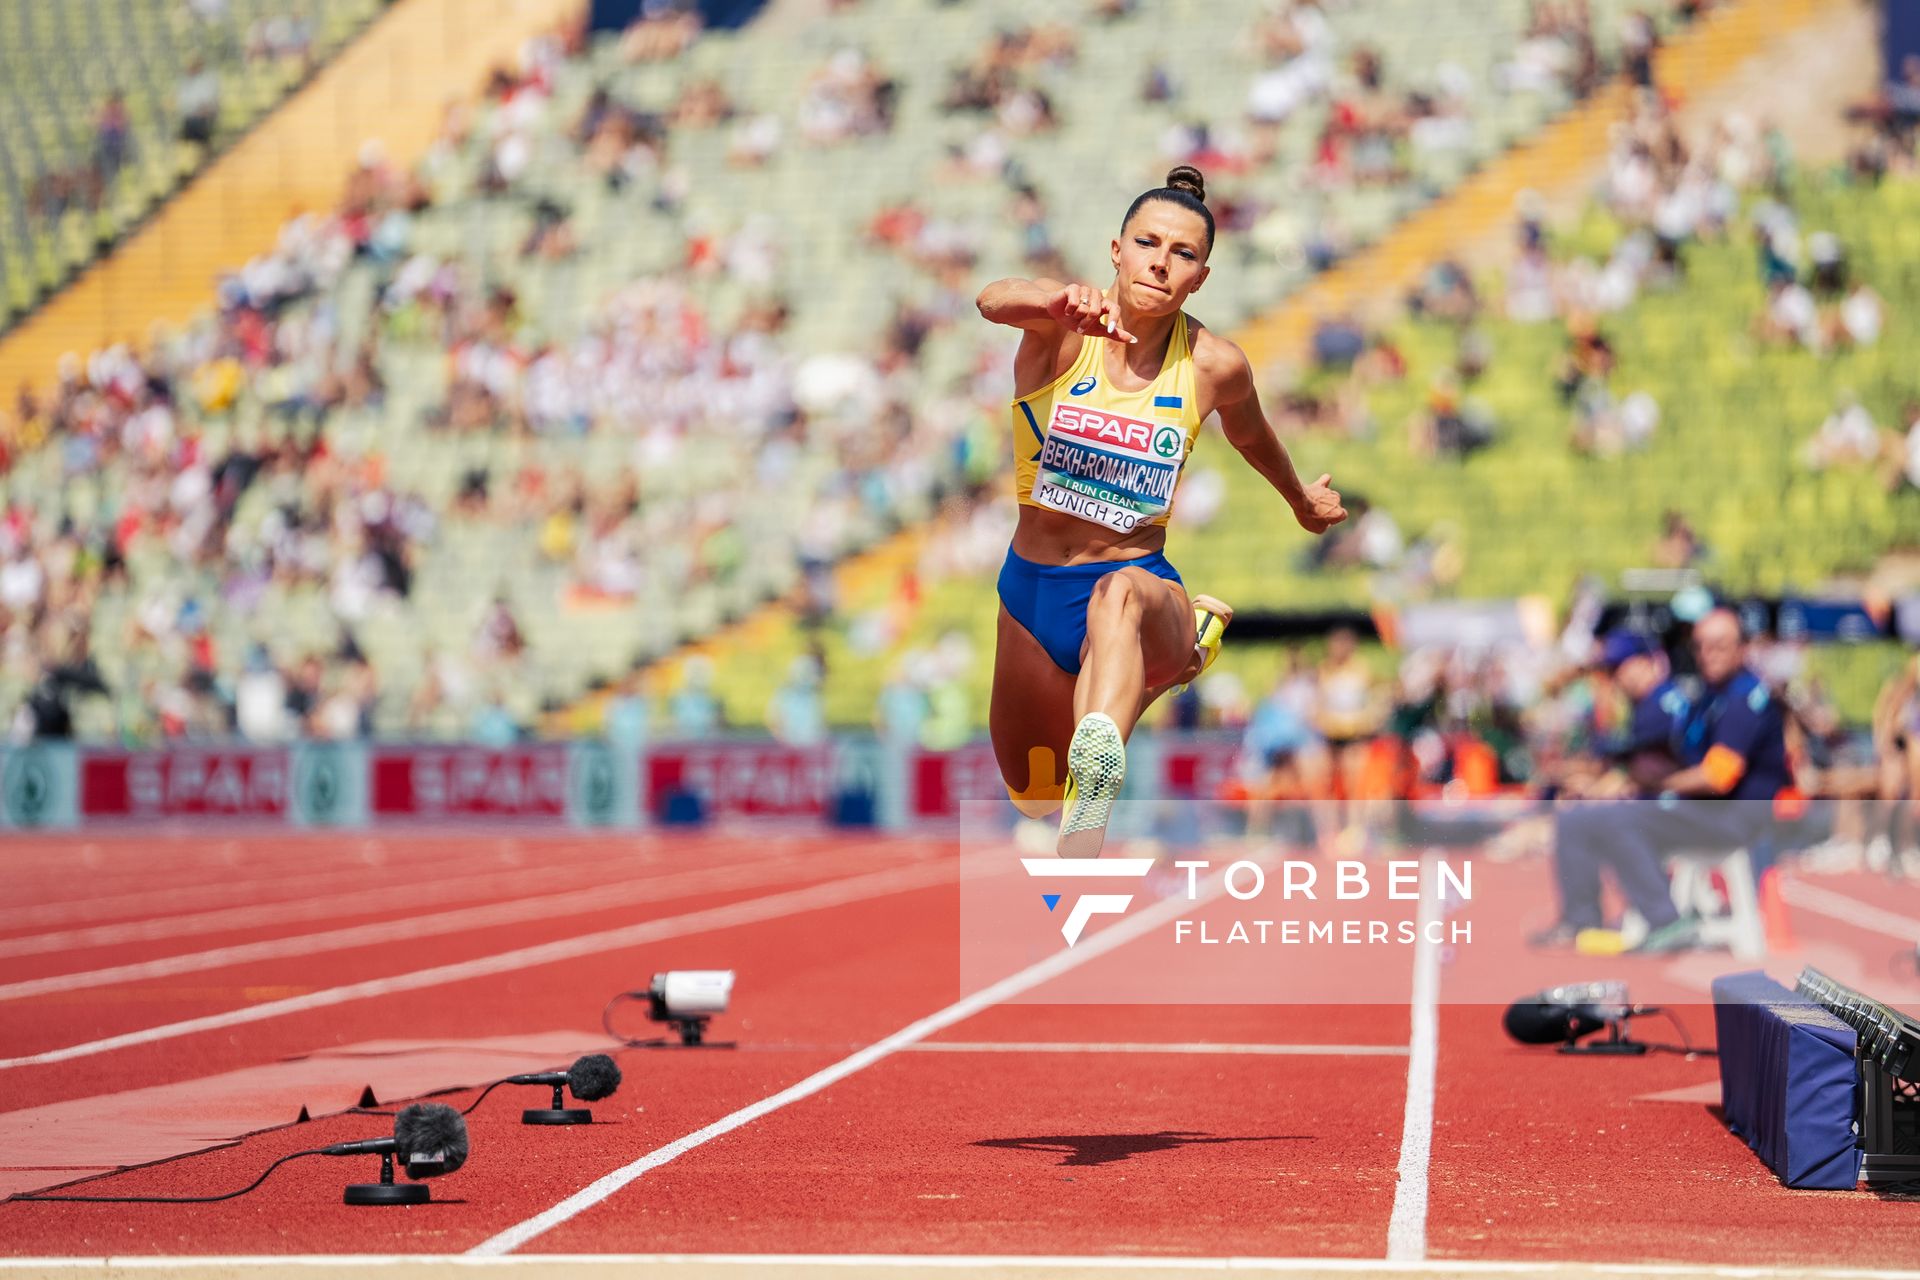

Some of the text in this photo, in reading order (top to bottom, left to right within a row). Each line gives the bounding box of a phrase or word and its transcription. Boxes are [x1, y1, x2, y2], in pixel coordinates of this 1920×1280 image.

[1056, 407, 1150, 448] SPAR
[1043, 440, 1174, 500] BEKH-ROMANCHUK
[1065, 480, 1071, 488] I
[1071, 481, 1097, 498] RUN
[1039, 484, 1151, 530] MUNICH 20
